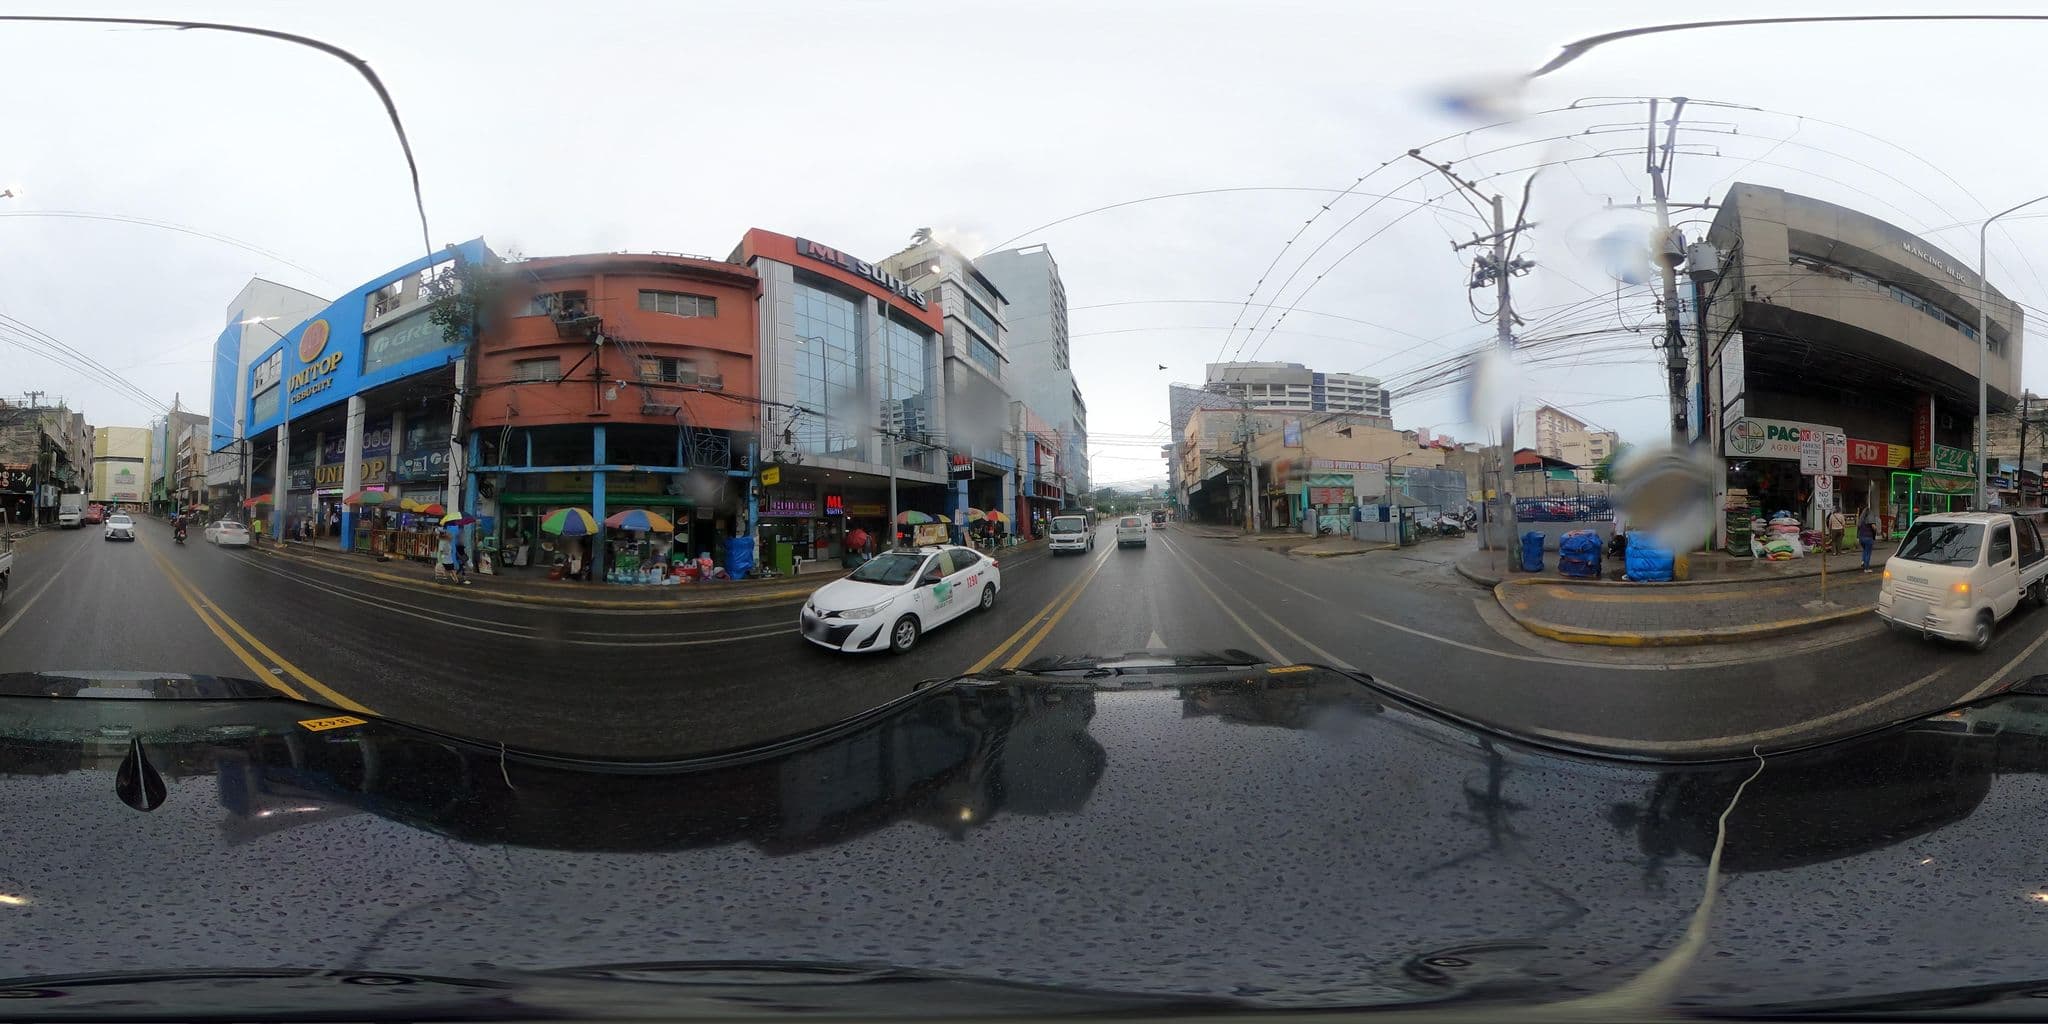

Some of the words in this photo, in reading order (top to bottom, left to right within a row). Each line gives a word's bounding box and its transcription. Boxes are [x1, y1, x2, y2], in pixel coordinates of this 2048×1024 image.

[1902, 241, 1943, 269] MANCING
[808, 240, 848, 266] ML
[857, 260, 926, 306] SUITES
[287, 352, 342, 393] UNITOP
[312, 378, 333, 393] CITY
[1767, 425, 1801, 443] PAC
[1801, 430, 1811, 442] NO
[1770, 442, 1801, 453] AGRIVE
[1855, 443, 1878, 461] RD
[316, 461, 384, 484] UNIOP
[953, 464, 971, 472] SUITES
[827, 495, 844, 507] ML
